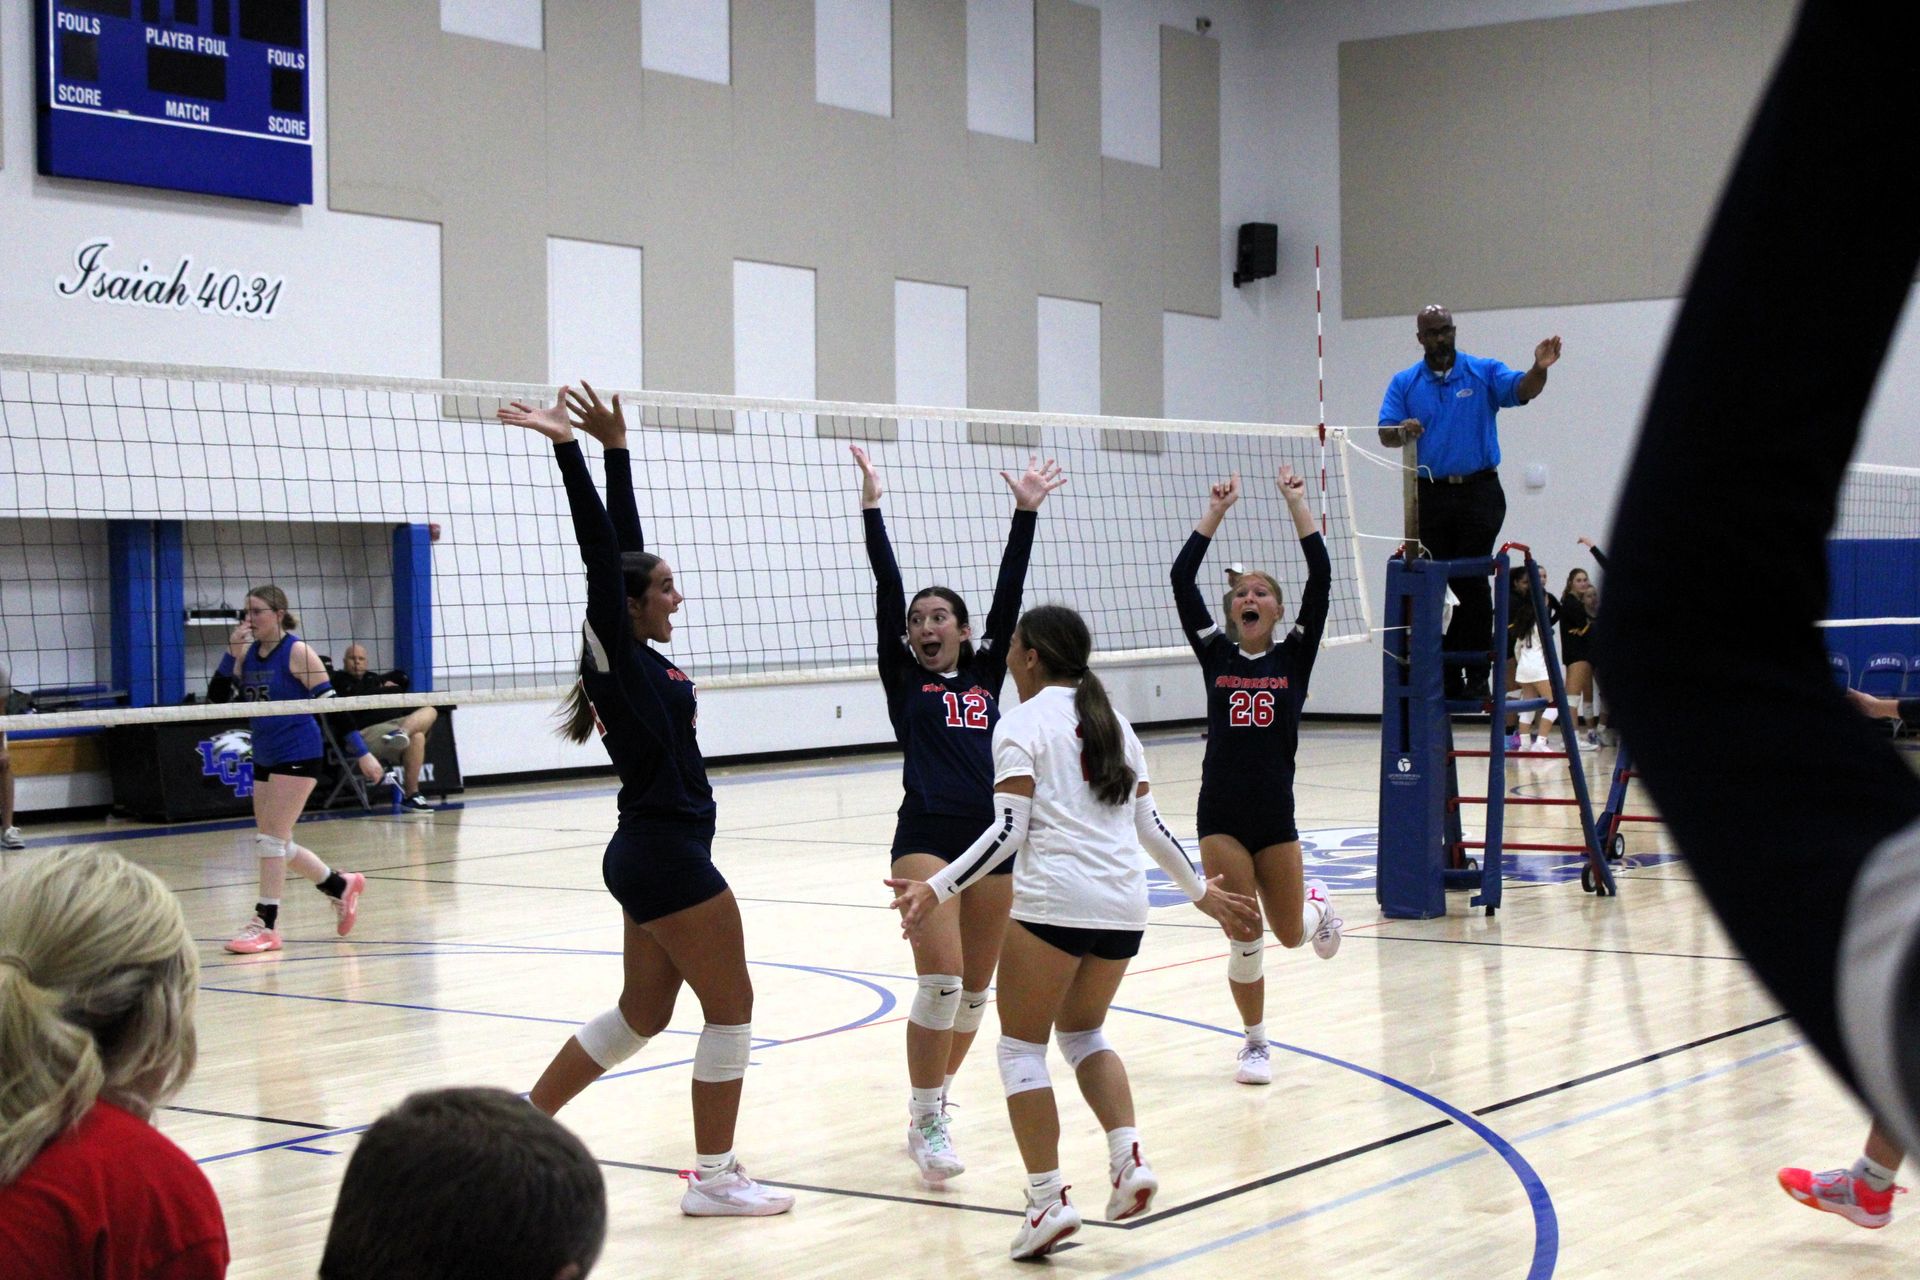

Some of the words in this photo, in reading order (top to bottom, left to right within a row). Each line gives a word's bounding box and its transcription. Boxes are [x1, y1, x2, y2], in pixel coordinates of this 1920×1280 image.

[57, 11, 101, 35] FOULS
[145, 27, 195, 51] PLAYER
[198, 36, 229, 57] FOUL
[267, 48, 306, 70] FOULS
[58, 84, 102, 107] SCORE
[165, 100, 210, 123] MATCH
[268, 115, 306, 136] SCORE
[59, 242, 191, 306] Isaiah
[197, 272, 284, 315] 40:31
[942, 691, 989, 730] 12
[1229, 690, 1275, 727] 26
